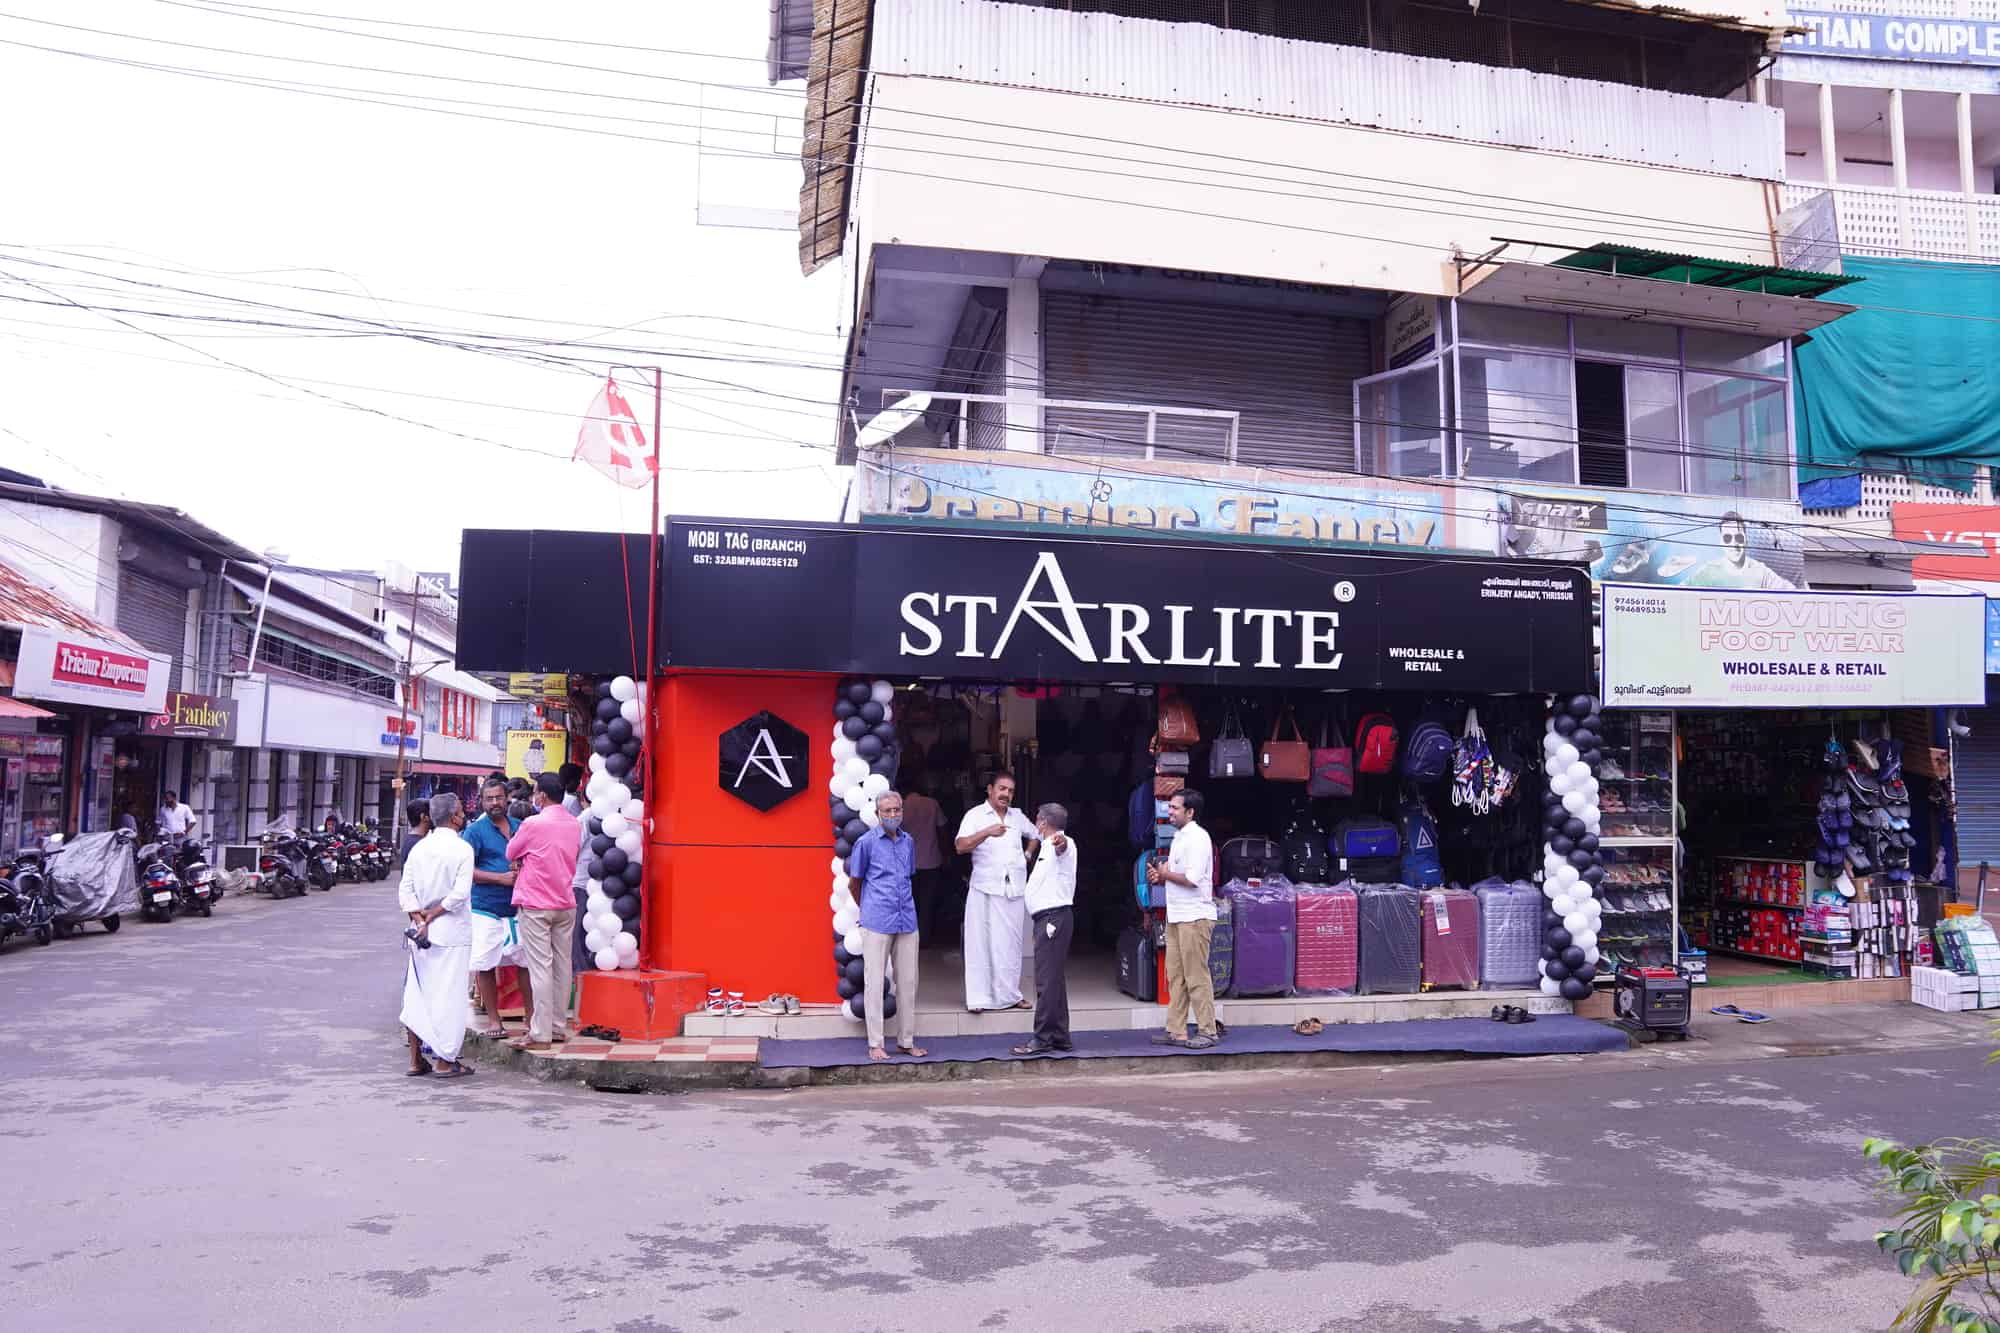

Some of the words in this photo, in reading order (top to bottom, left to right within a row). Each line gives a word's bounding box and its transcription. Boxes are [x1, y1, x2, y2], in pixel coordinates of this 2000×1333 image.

[688, 530, 719, 548] MOBI
[725, 532, 748, 550] TAG
[751, 538, 807, 555] (BRANCH)
[694, 555, 712, 564] GST:
[1481, 588, 1513, 598] ERINJERY
[1542, 591, 1574, 601] THRISSUR
[899, 552, 1343, 671] STARLITE
[1699, 598, 1907, 629] MOVING
[1700, 630, 1795, 651] FOOT
[1804, 632, 1904, 653] WEAR
[1389, 647, 1454, 660] WHOLESALE
[1456, 650, 1465, 660] &
[60, 648, 100, 677] Trichur
[101, 656, 147, 685] Emporium
[1405, 661, 1443, 672] RETAIL
[1723, 662, 1817, 676] WHOLESALE
[1820, 663, 1831, 676] &
[1836, 663, 1887, 676] RETAIL
